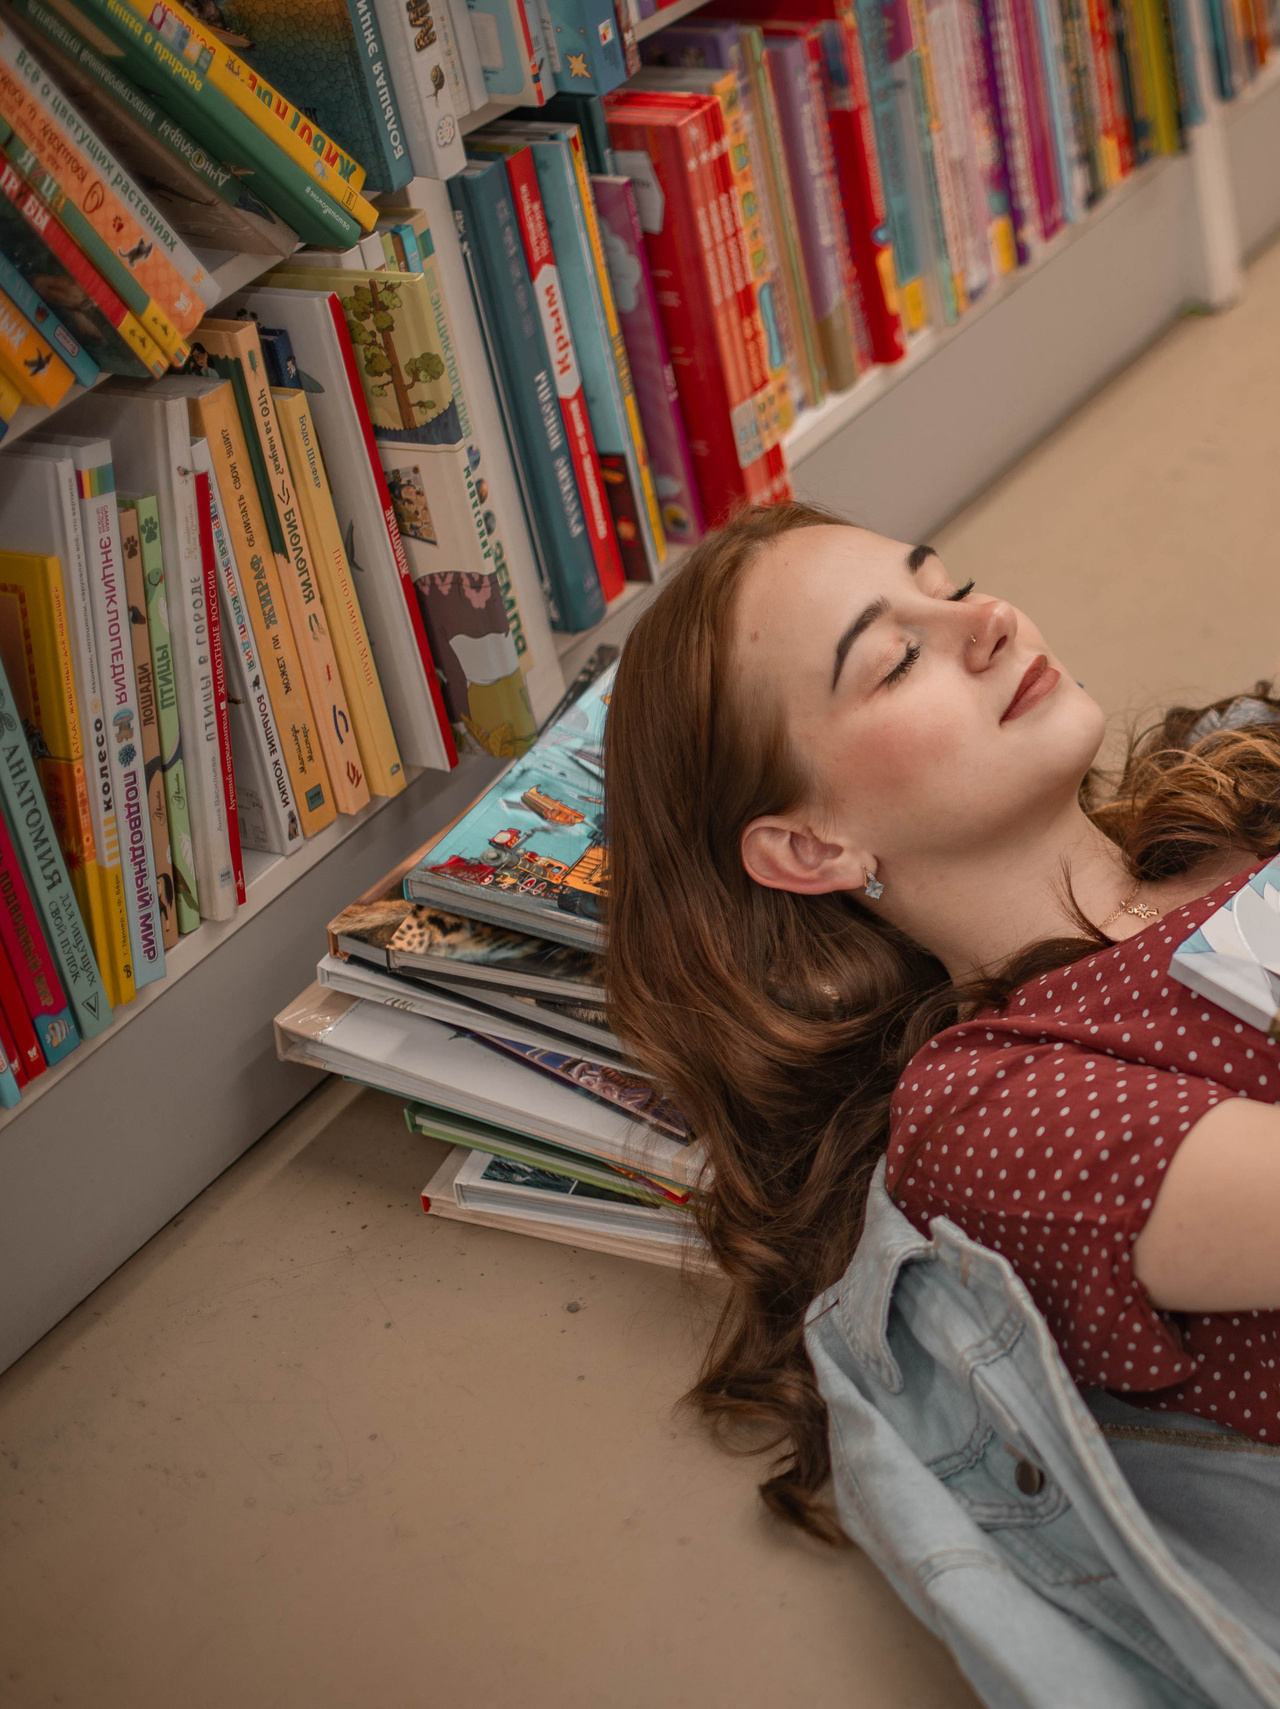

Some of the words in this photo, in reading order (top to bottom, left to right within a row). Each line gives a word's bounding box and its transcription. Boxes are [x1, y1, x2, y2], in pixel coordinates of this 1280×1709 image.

[79, 49, 155, 121] ИЛЛЮСТРИРОВАННЫЙ
[142, 33, 153, 44] о
[153, 41, 203, 91] природе
[27, 103, 38, 121] и
[372, 61, 404, 159] БОЛЬШАЯ
[12, 49, 41, 83] Всё
[37, 83, 51, 97] о
[51, 95, 114, 172] цветущих
[110, 173, 177, 252] растениях
[39, 119, 88, 183] кошках
[158, 121, 229, 187] ДИНОЗАВРЫ
[544, 284, 571, 375] Крым
[430, 293, 472, 439] ЭНЦИКЛОПЕДИЯ
[257, 388, 271, 417] ЧТО
[263, 419, 273, 435] за
[220, 428, 234, 458] УШИ?
[267, 435, 285, 475] наука?
[229, 461, 242, 490] СВОИ
[237, 494, 256, 548] ОБЛИЗАТЬ
[385, 506, 409, 578] ЖИВОТНЫЕ
[208, 504, 227, 556] ПЕРВАЯ
[222, 558, 255, 669] ЭНЦИКЛОПЕДИЯ
[283, 508, 315, 604] БИОЛОГИЯ
[54, 586, 65, 636] малышей
[99, 536, 128, 705] ЭНЦИКЛОПЕДИЯ
[190, 576, 206, 645] ГОРОДЕ
[207, 569, 219, 620] РОССИИ
[249, 554, 278, 630] ЖИРАФ
[60, 639, 68, 657] для
[82, 603, 92, 652] мотоциклы,
[197, 654, 208, 664] В
[271, 634, 281, 649] ЛИ
[88, 656, 97, 693] Машины,
[155, 644, 176, 709] ПТИЦЫ
[212, 625, 225, 695] ЖИВОТНЫЕ
[275, 656, 292, 695] МОЖЕТ
[137, 662, 155, 727] ЛОШАДИ
[199, 674, 216, 741] ПТИЦЫ
[68, 719, 80, 754] АТЛАС
[93, 718, 113, 812] колесо
[221, 710, 232, 773] определитель
[256, 695, 278, 756] БОЛЬШИЕ
[272, 760, 290, 807] КОШКИ
[290, 723, 307, 774] Матильда
[300, 723, 315, 763] Мастерс
[210, 756, 221, 806] Васильева
[226, 773, 236, 810] Лучший
[4, 745, 62, 890] АНАТОМИЯ
[214, 807, 223, 831] Анна
[124, 771, 153, 909] ПОДВОДНЫЙ
[139, 912, 158, 961] МИР
[0, 870, 40, 972] ПОДВОДНЫЙ
[34, 973, 54, 1006] МИР
[48, 900, 67, 936] СВОЙ
[59, 938, 81, 984] ПУПОК
[58, 892, 76, 920] ДЛЯ
[70, 921, 97, 987] ИЩУЩИХ
